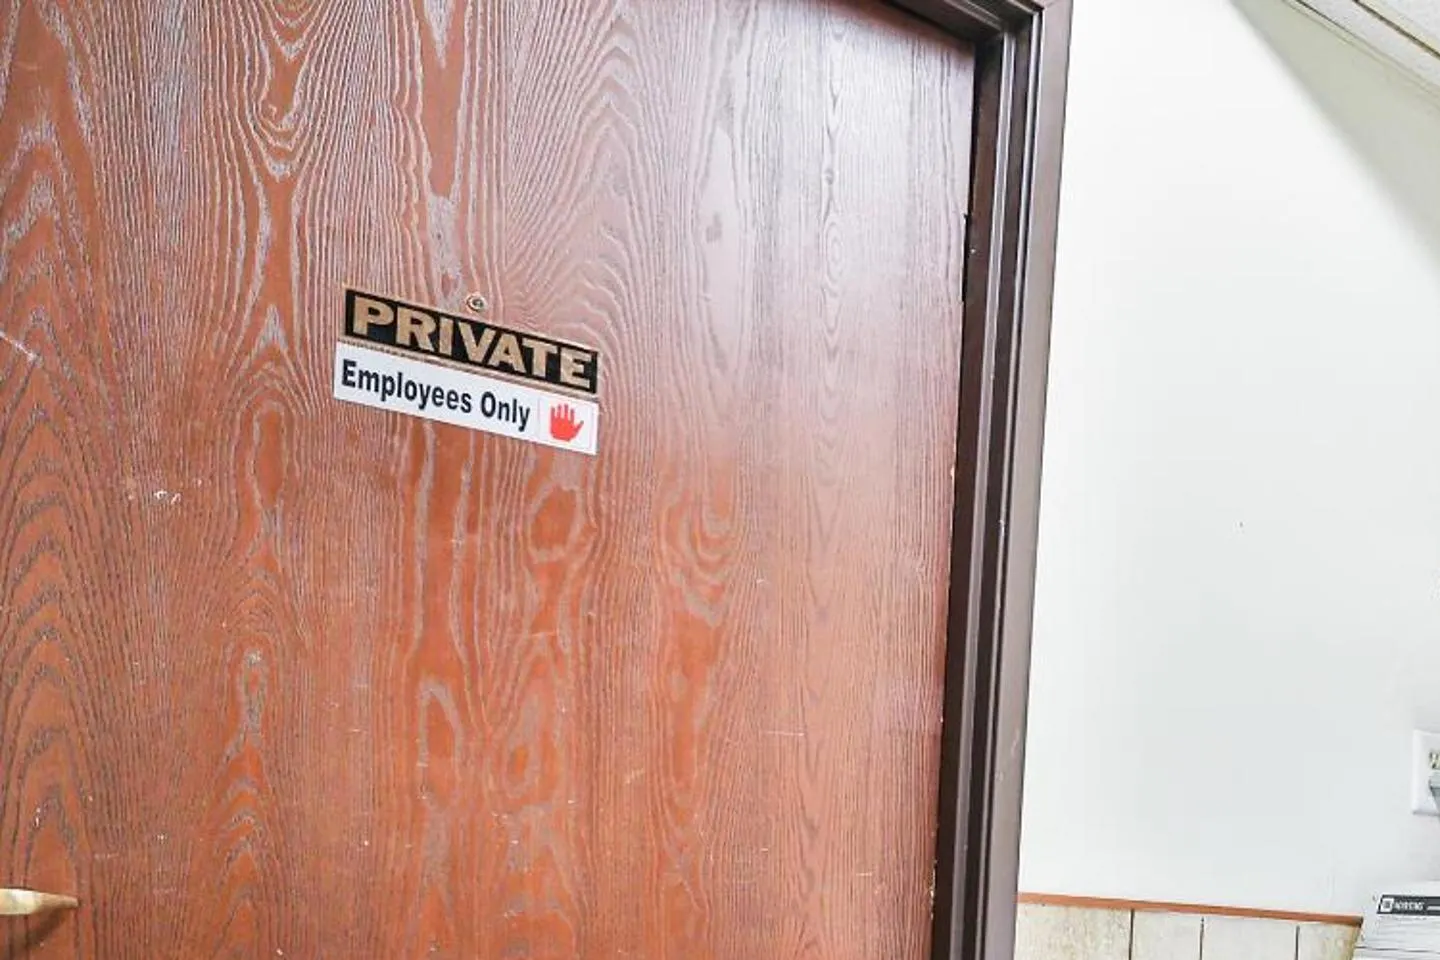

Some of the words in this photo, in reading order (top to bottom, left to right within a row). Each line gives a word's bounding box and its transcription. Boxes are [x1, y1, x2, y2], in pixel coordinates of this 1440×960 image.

[352, 295, 591, 390] PRIVATE
[341, 359, 472, 415] Employees
[480, 391, 531, 432] Only
